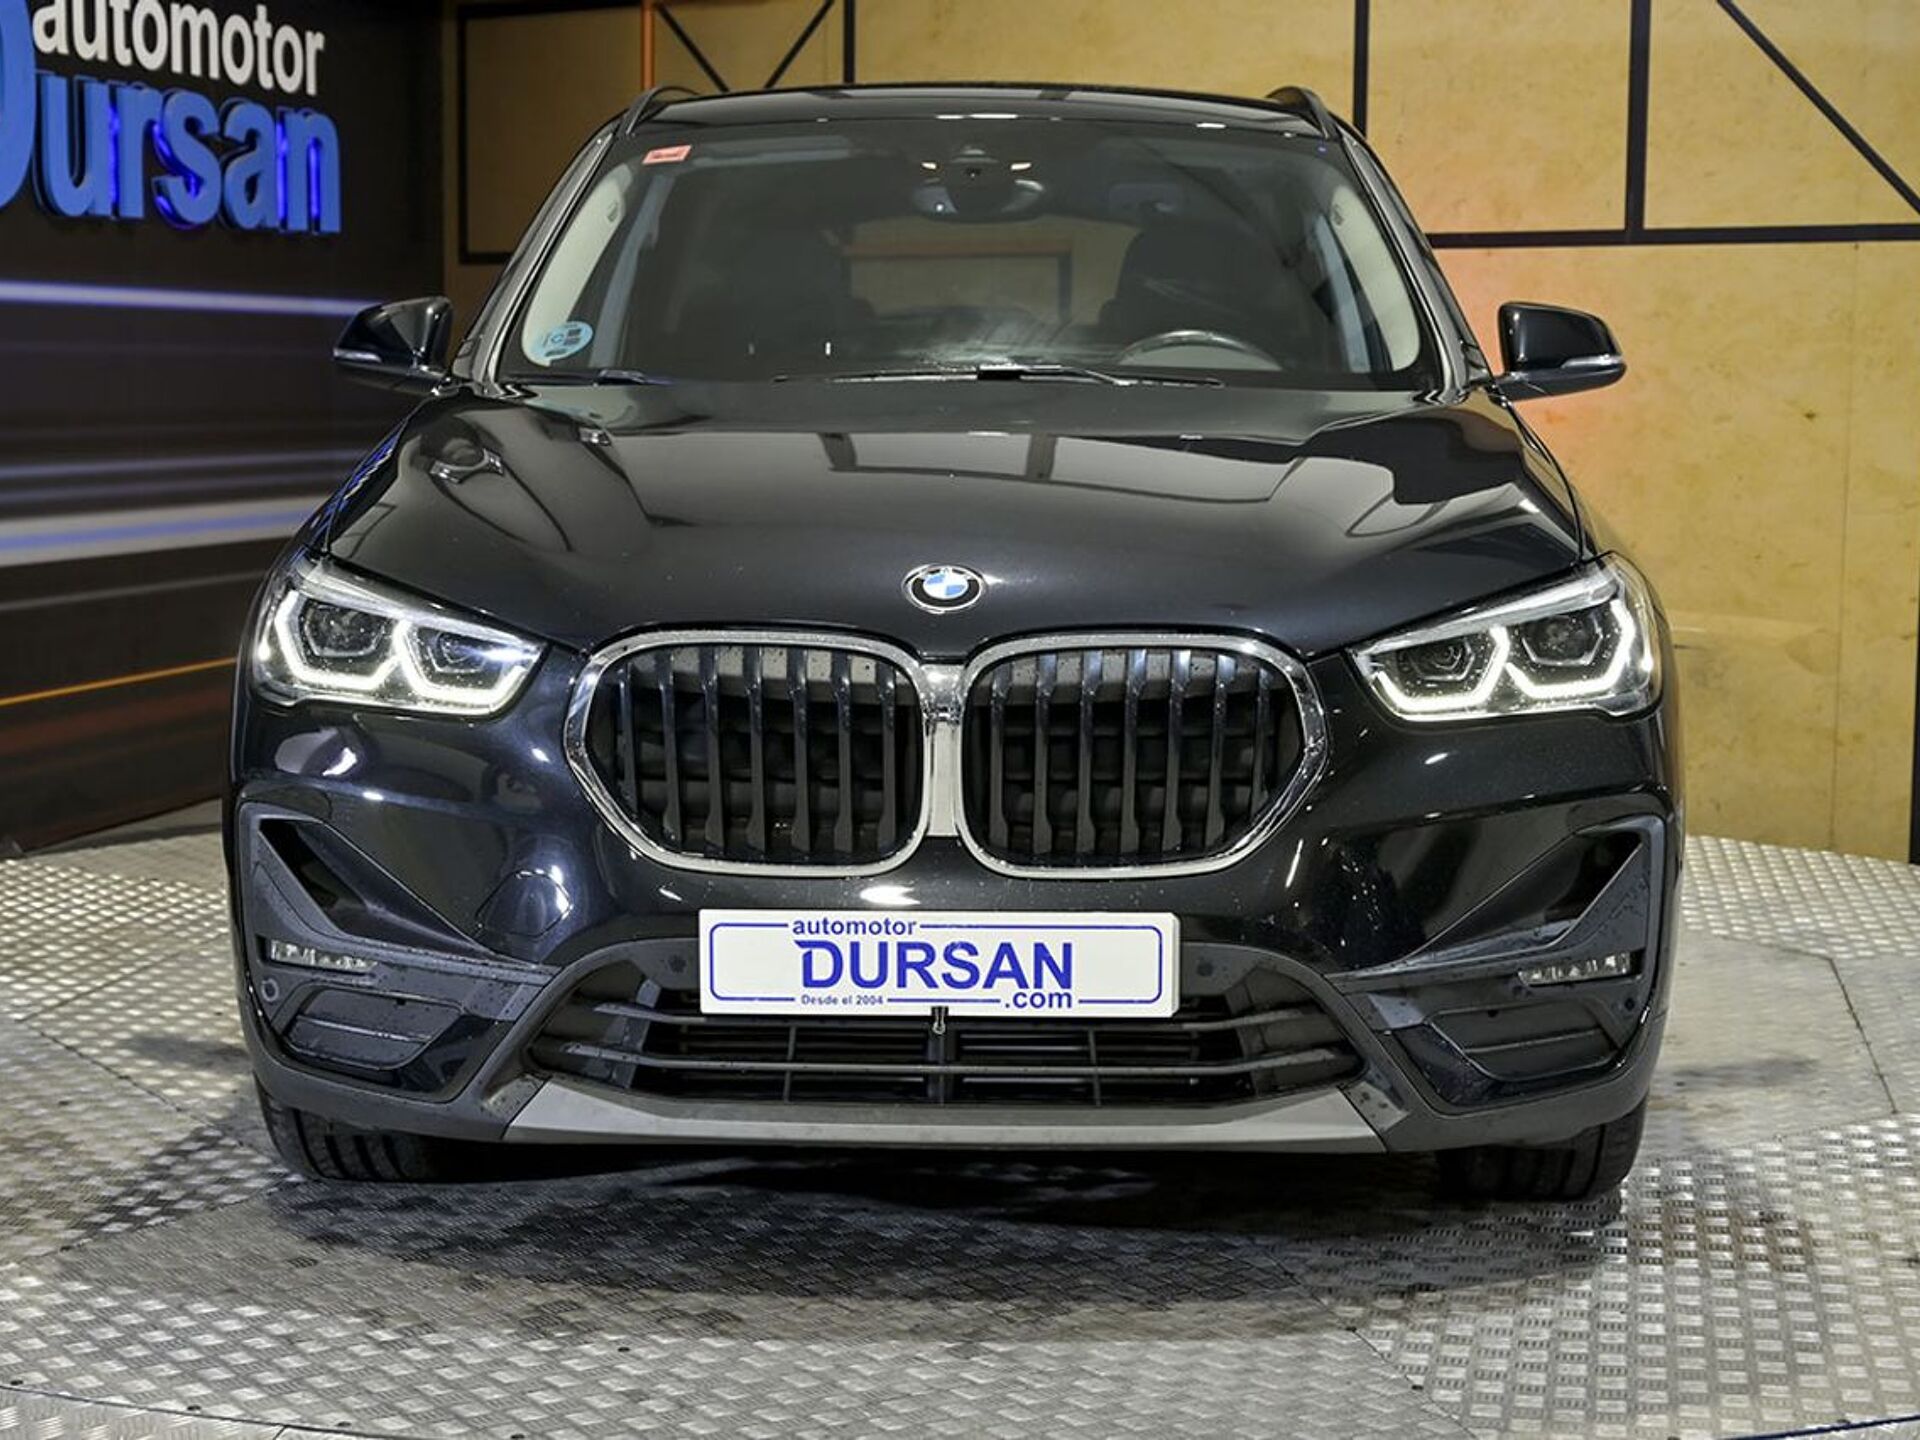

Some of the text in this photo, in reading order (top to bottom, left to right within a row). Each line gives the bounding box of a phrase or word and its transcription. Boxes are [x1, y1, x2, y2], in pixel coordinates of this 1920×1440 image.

[32, 0, 325, 96] automotor
[792, 917, 917, 936] automotor
[794, 940, 1072, 989] DURSAN
[1005, 991, 1072, 1009] .com
